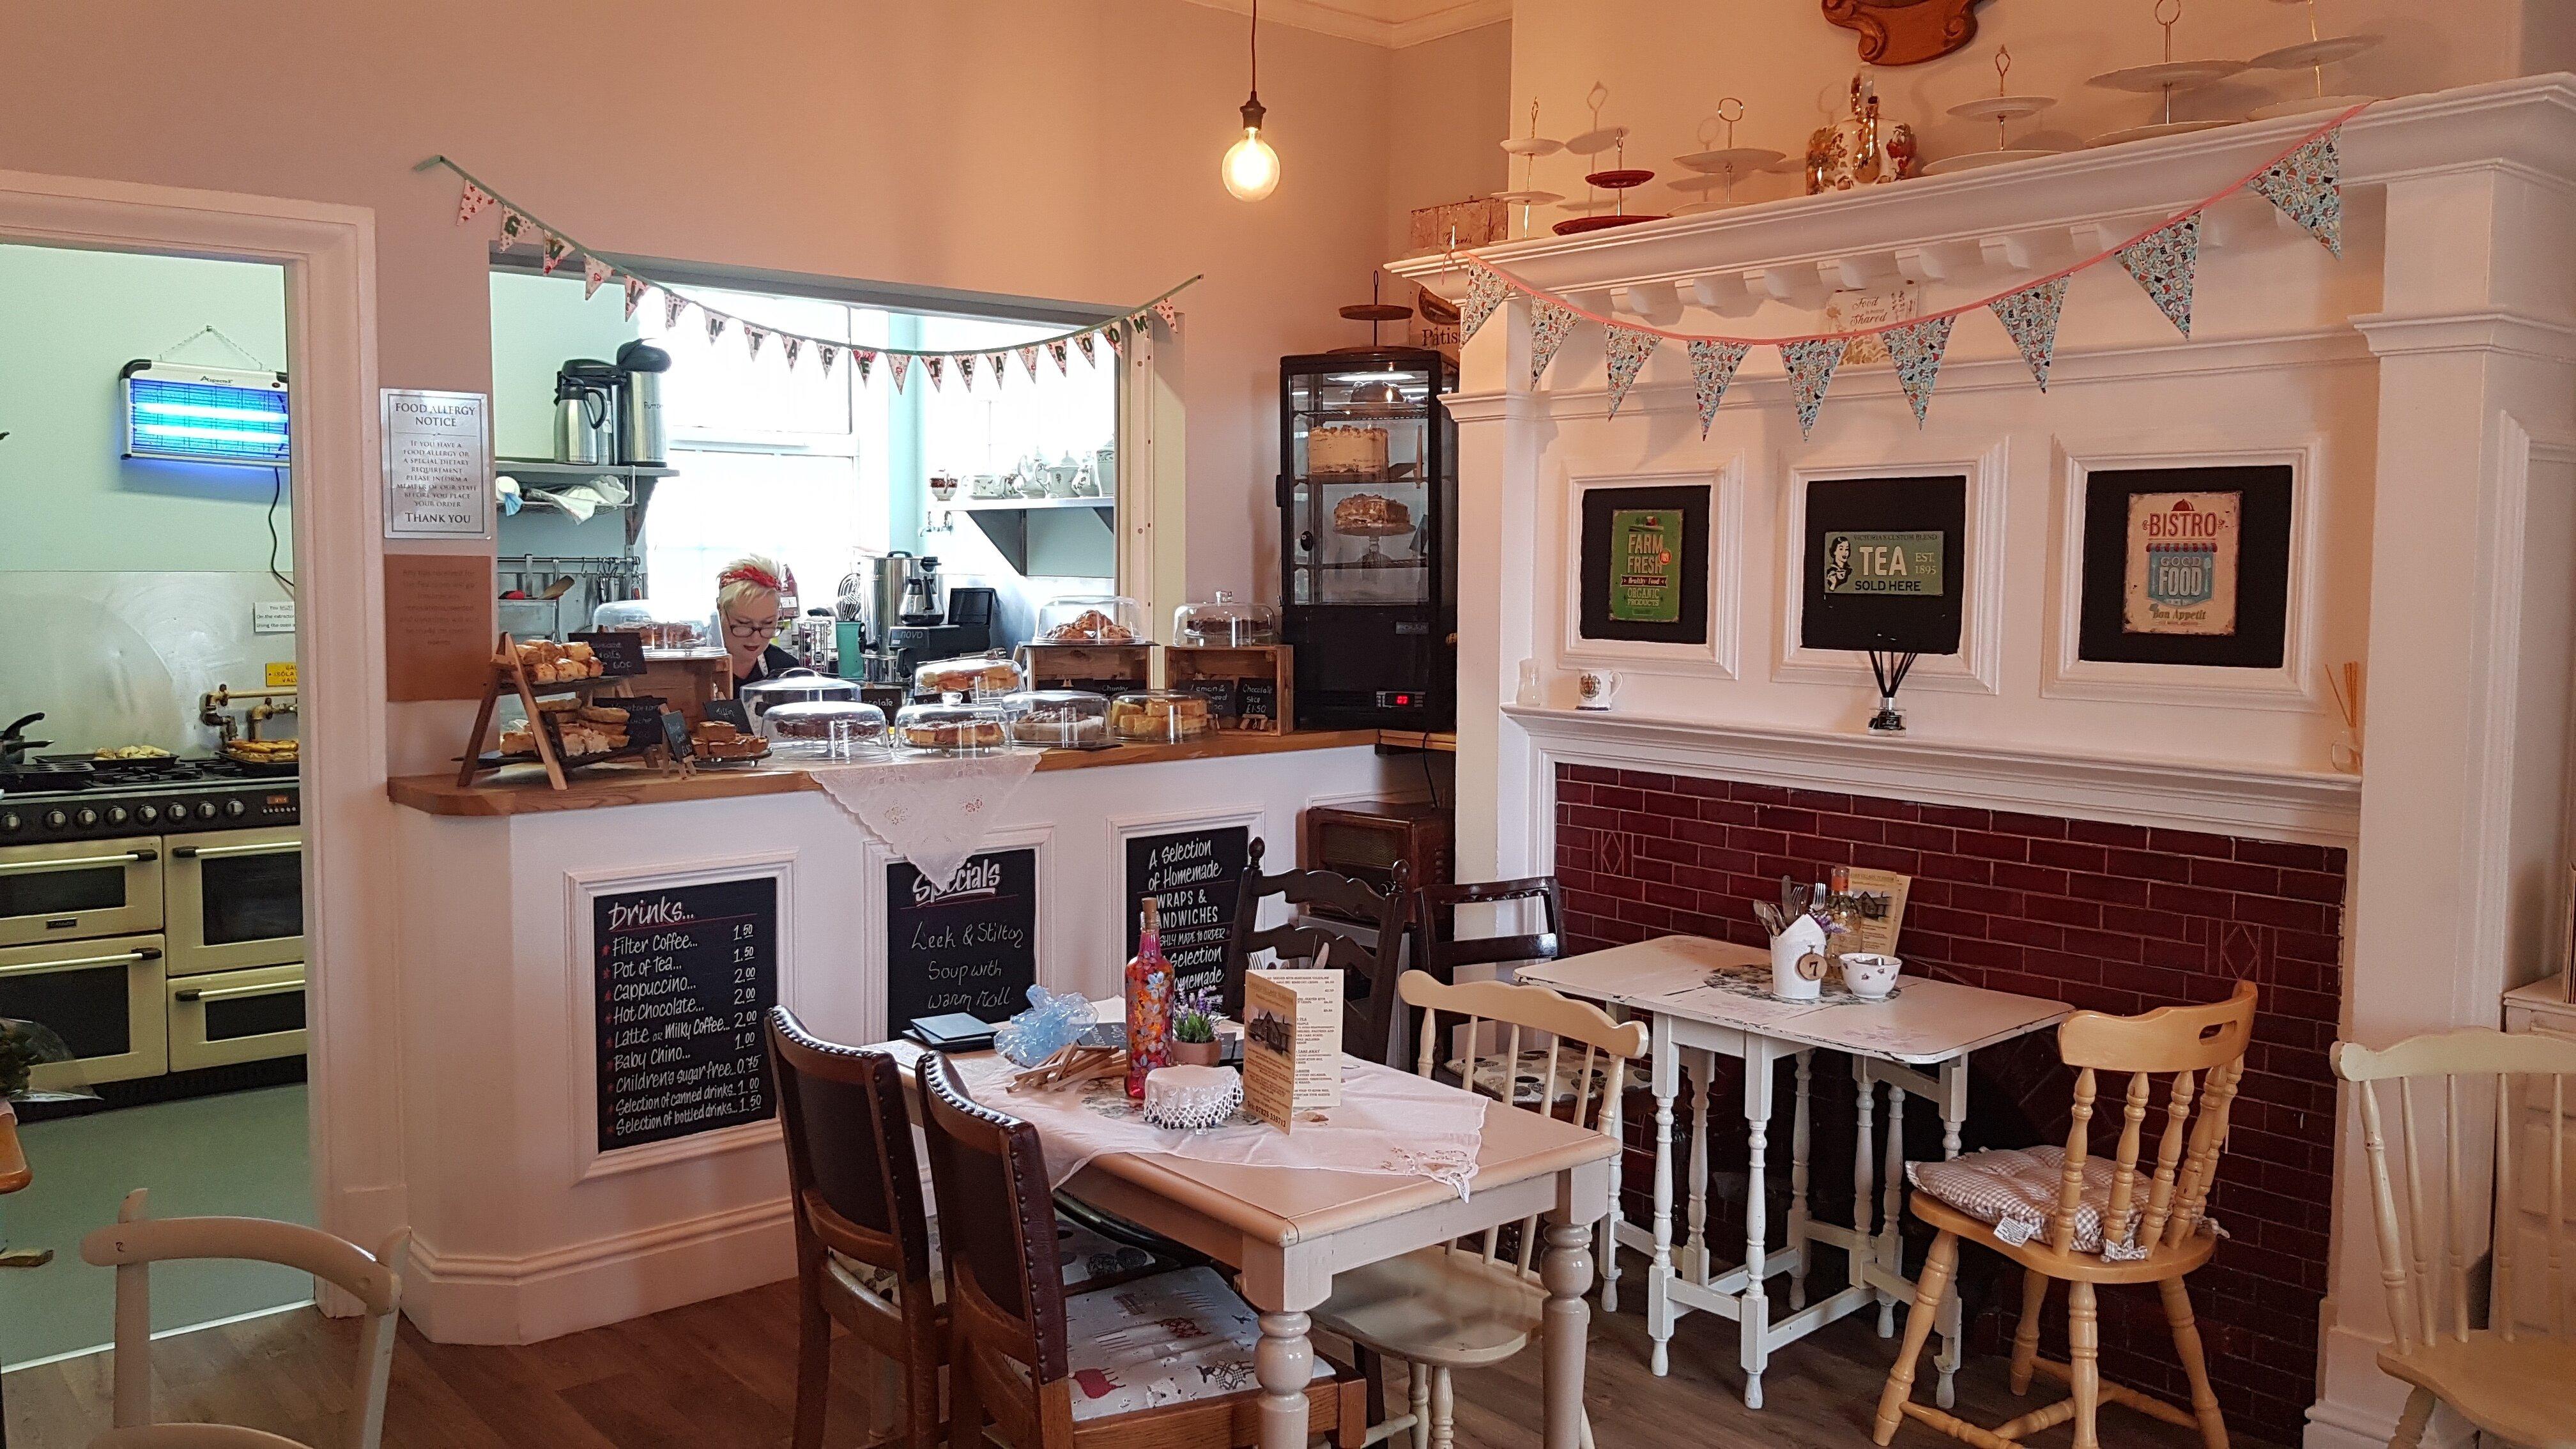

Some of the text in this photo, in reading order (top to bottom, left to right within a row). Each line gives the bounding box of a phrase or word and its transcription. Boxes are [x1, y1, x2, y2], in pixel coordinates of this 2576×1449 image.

[1851, 296, 1880, 309] Food
[1850, 312, 1887, 326] Shared
[395, 402, 475, 415] FOOD ALLERGY
[415, 417, 457, 427] NOTICE
[404, 512, 471, 524] THANK YOU
[2149, 512, 2217, 537] BISTRO
[1628, 533, 1664, 555] FARM
[1627, 555, 1662, 574] FRESH
[1859, 546, 1907, 576] TEA
[1915, 565, 1936, 575] 1895
[2160, 556, 2202, 567] GOOD
[1855, 580, 1921, 592] SOLD HERE
[2158, 566, 2202, 596] FOOD
[1627, 587, 1660, 599] ORGANIC
[900, 630, 923, 640] novo
[1149, 838, 1212, 870] A Selection
[1148, 859, 1223, 892] of Homemade
[1156, 888, 1208, 909] WRAPS &
[612, 935, 648, 957] Filter
[912, 921, 956, 950] Leek
[962, 923, 974, 947] &
[1177, 931, 1196, 946] MADE
[1203, 928, 1225, 942] ORDER
[613, 960, 636, 979] Pot
[639, 959, 652, 977] of
[733, 946, 755, 963] 1.50
[1170, 946, 1222, 969] Selection
[1809, 960, 1819, 977] 7
[733, 967, 756, 984] 2.00
[928, 959, 1002, 986] Soup with
[1174, 965, 1225, 991] omemade
[613, 1006, 638, 1025] Hot
[733, 987, 756, 1005] 2.00
[614, 1028, 650, 1049] Latte
[664, 1022, 692, 1041] Milky
[613, 1050, 647, 1073] Baby
[616, 1069, 675, 1093] Children's
[677, 1066, 707, 1085] sugar
[616, 1095, 661, 1116] Selection
[661, 1091, 670, 1109] of
[671, 1084, 703, 1107] canned
[616, 1115, 663, 1136] Selection
[663, 1111, 673, 1128] of
[674, 1105, 704, 1125] bottled
